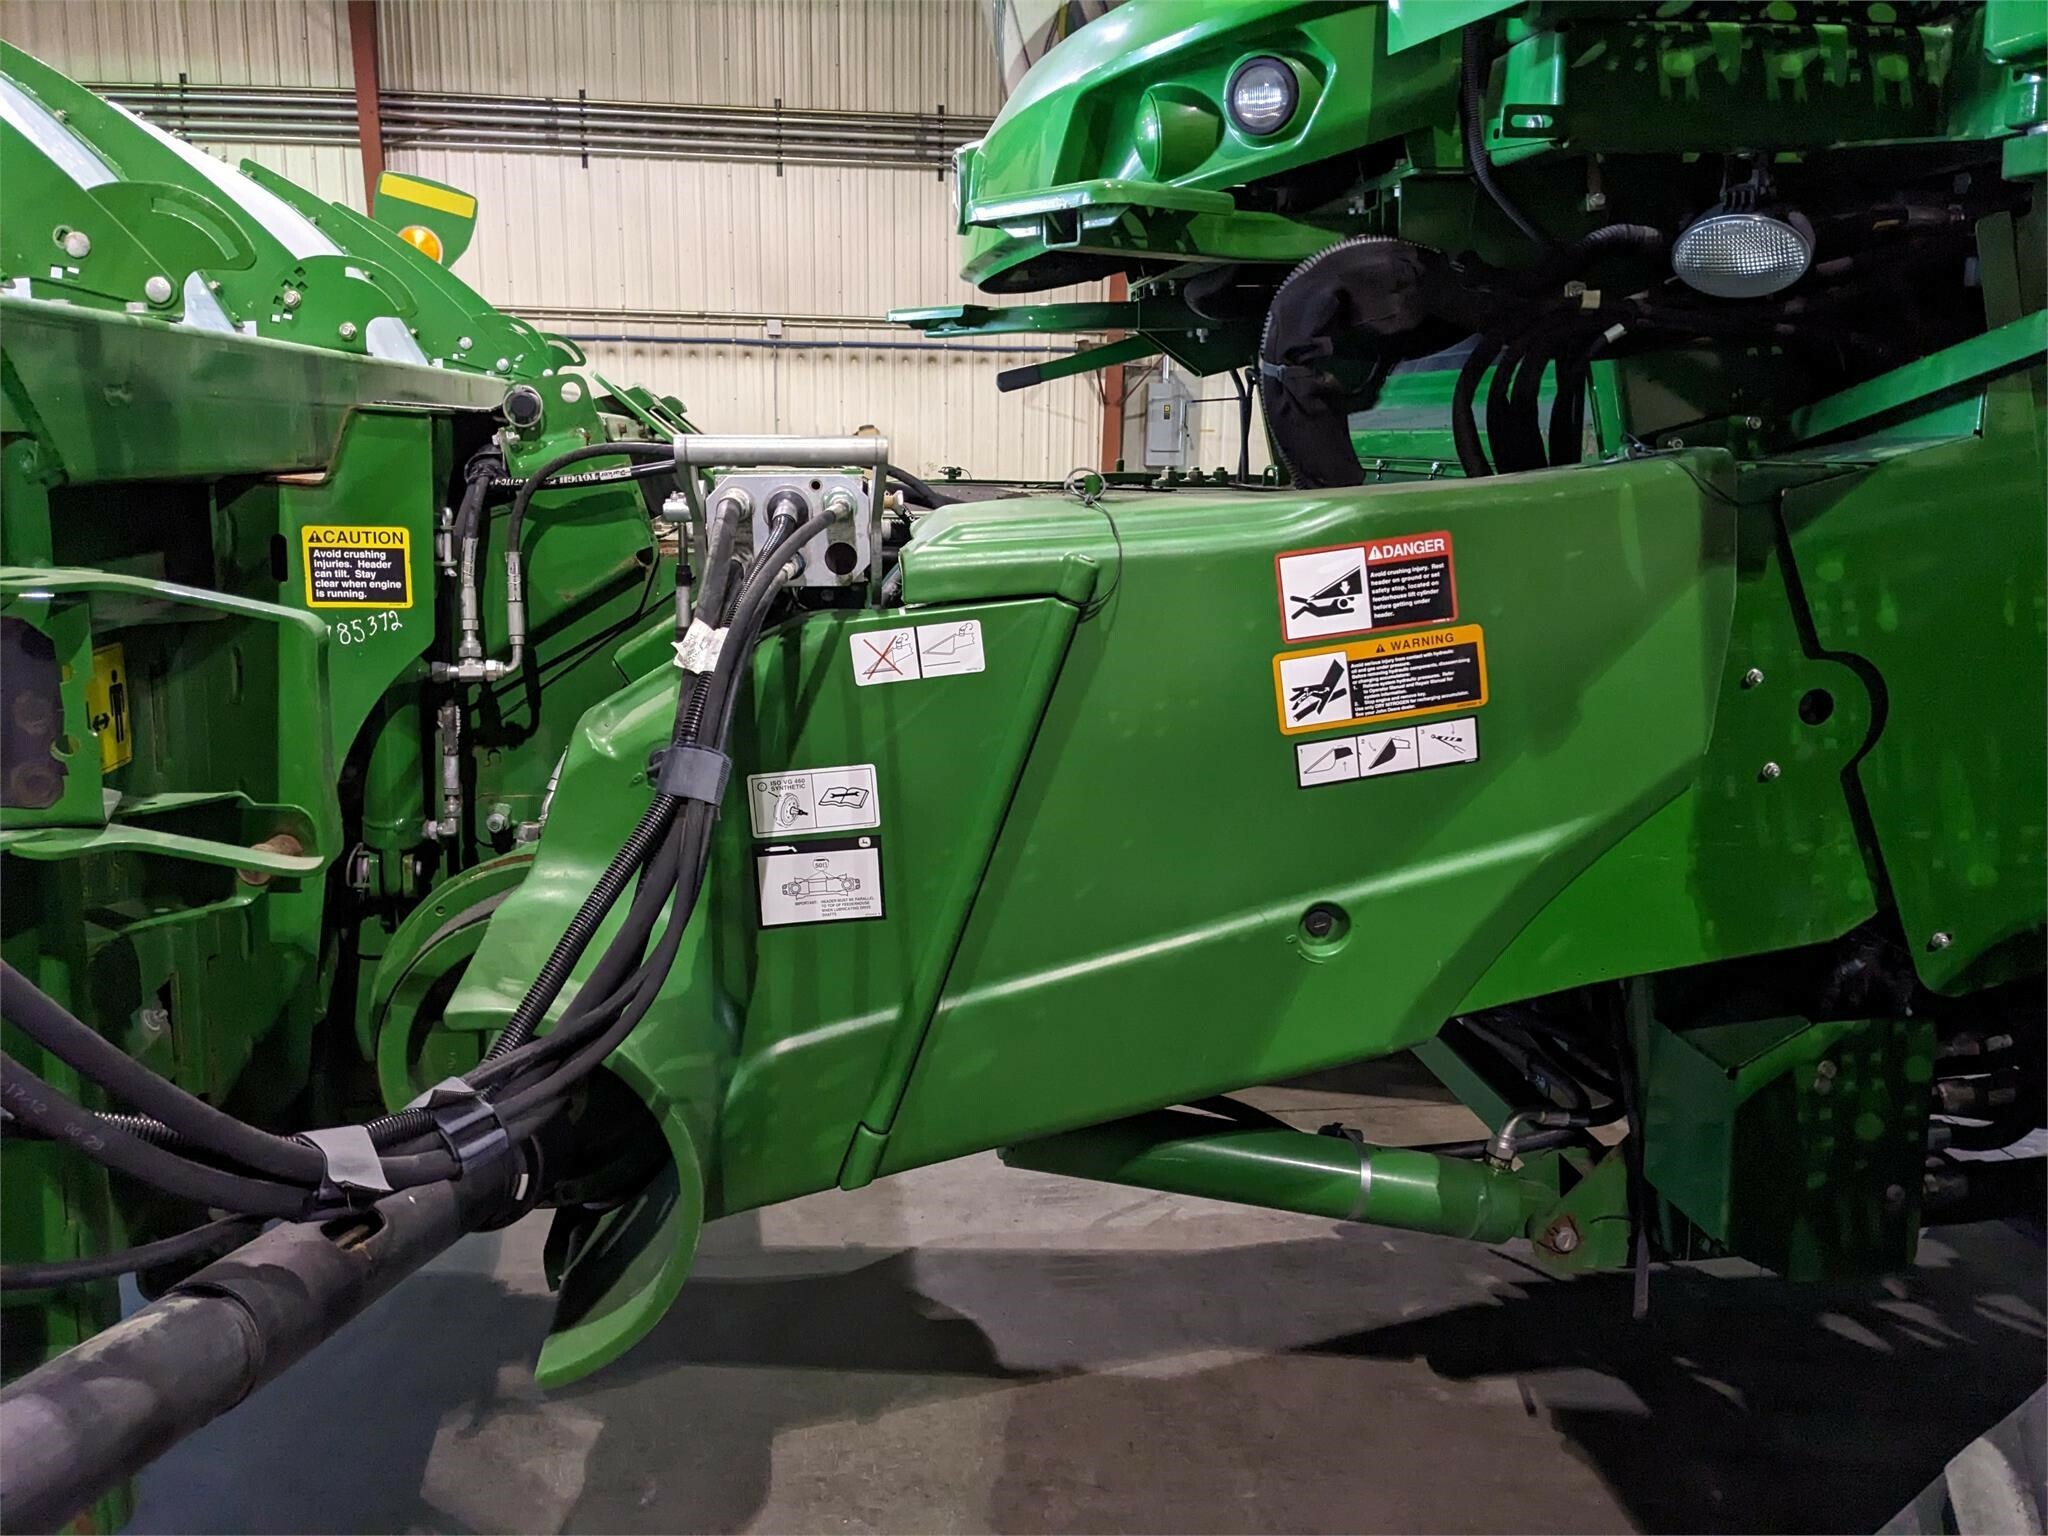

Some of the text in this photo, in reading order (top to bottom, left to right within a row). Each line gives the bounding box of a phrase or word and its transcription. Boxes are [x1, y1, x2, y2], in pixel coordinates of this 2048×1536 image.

[323, 530, 403, 544] CAUTION
[1383, 539, 1444, 558] DANGER
[314, 549, 386, 560] Avoid crushing
[314, 560, 392, 569] injuries. Header
[355, 570, 376, 580] Stay
[1387, 568, 1411, 576] crushing
[1412, 566, 1429, 574] injury.
[1401, 575, 1422, 583] ground
[342, 580, 366, 588] when
[369, 580, 401, 590] engine
[327, 590, 367, 599] running.
[1372, 586, 1390, 595] safety
[1372, 592, 1407, 602] feederhouse
[1417, 589, 1439, 597] cylinder
[1393, 600, 1413, 609] getting
[1391, 633, 1454, 651] WARNING
